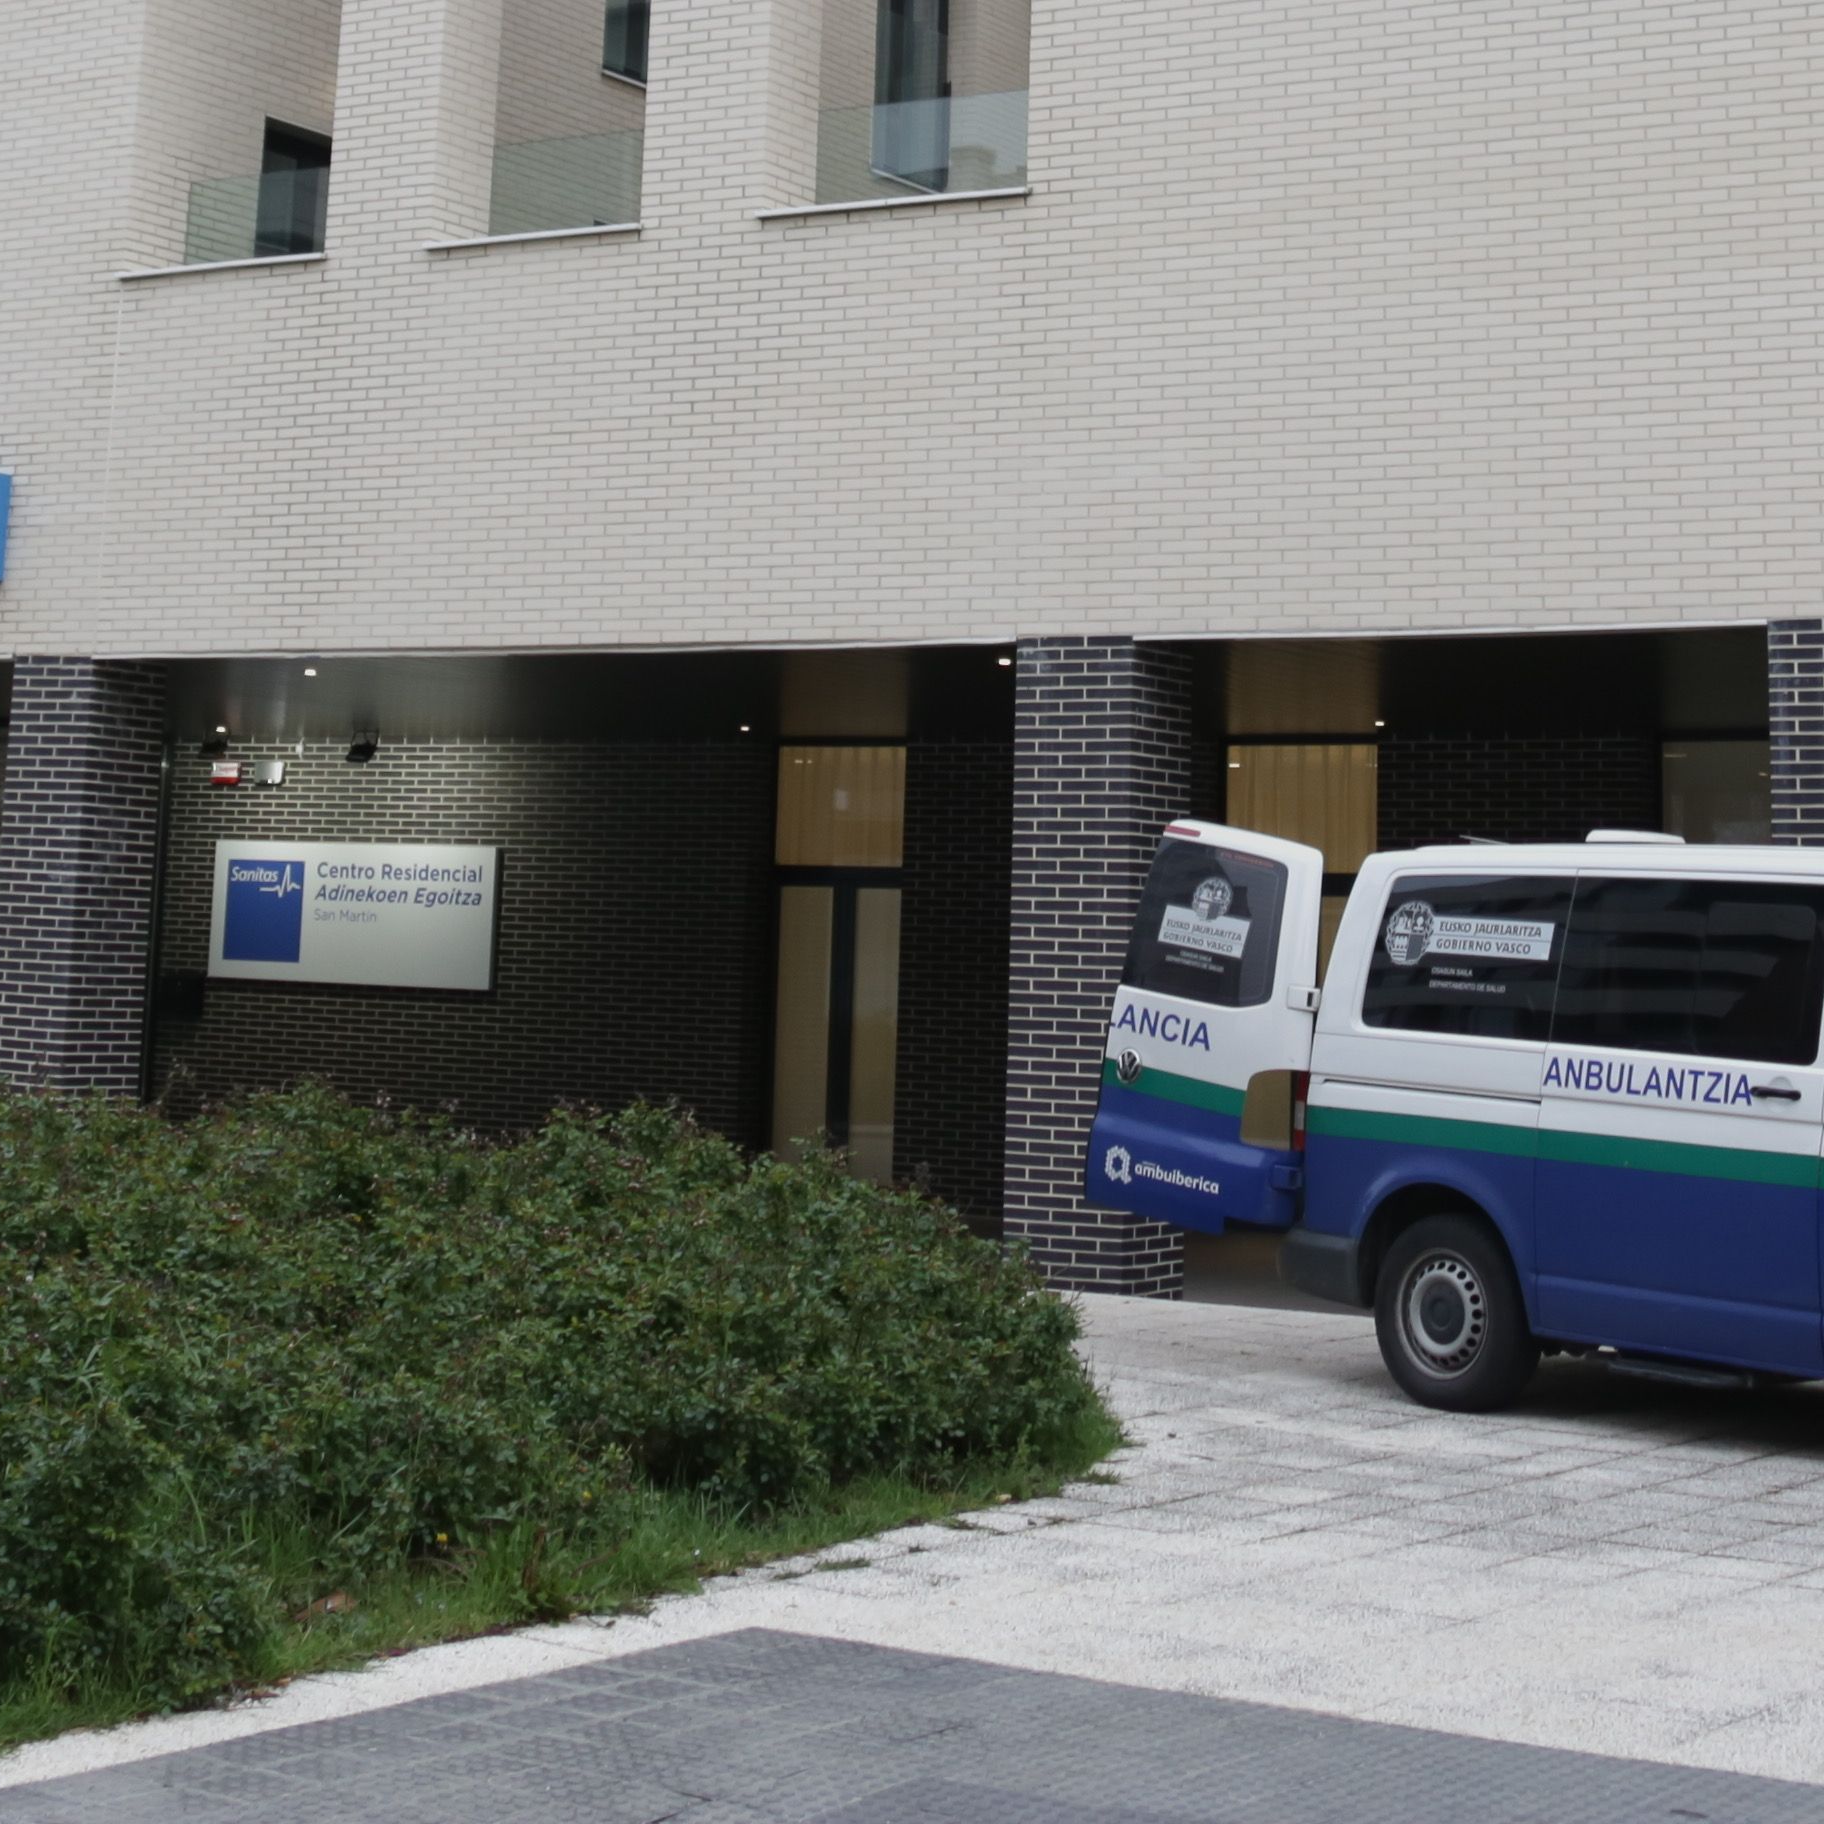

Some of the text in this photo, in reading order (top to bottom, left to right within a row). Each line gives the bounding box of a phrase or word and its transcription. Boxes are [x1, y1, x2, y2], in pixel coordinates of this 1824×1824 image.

[229, 866, 279, 883] Sanitas
[316, 862, 483, 883] Centro Residencial
[314, 884, 483, 908] Adinekoen Egoitza
[313, 907, 336, 922] San
[1166, 918, 1242, 941] EUSKO JAURLARITZA
[1438, 921, 1542, 937] EUSKO JAURLARITZA
[1163, 931, 1233, 952] GOBIERNO VASCO
[1435, 938, 1531, 954] GOBIERNO VASCO
[1542, 1056, 1754, 1107] ANBULANTZIA
[1133, 1163, 1220, 1195] ambuiberica
